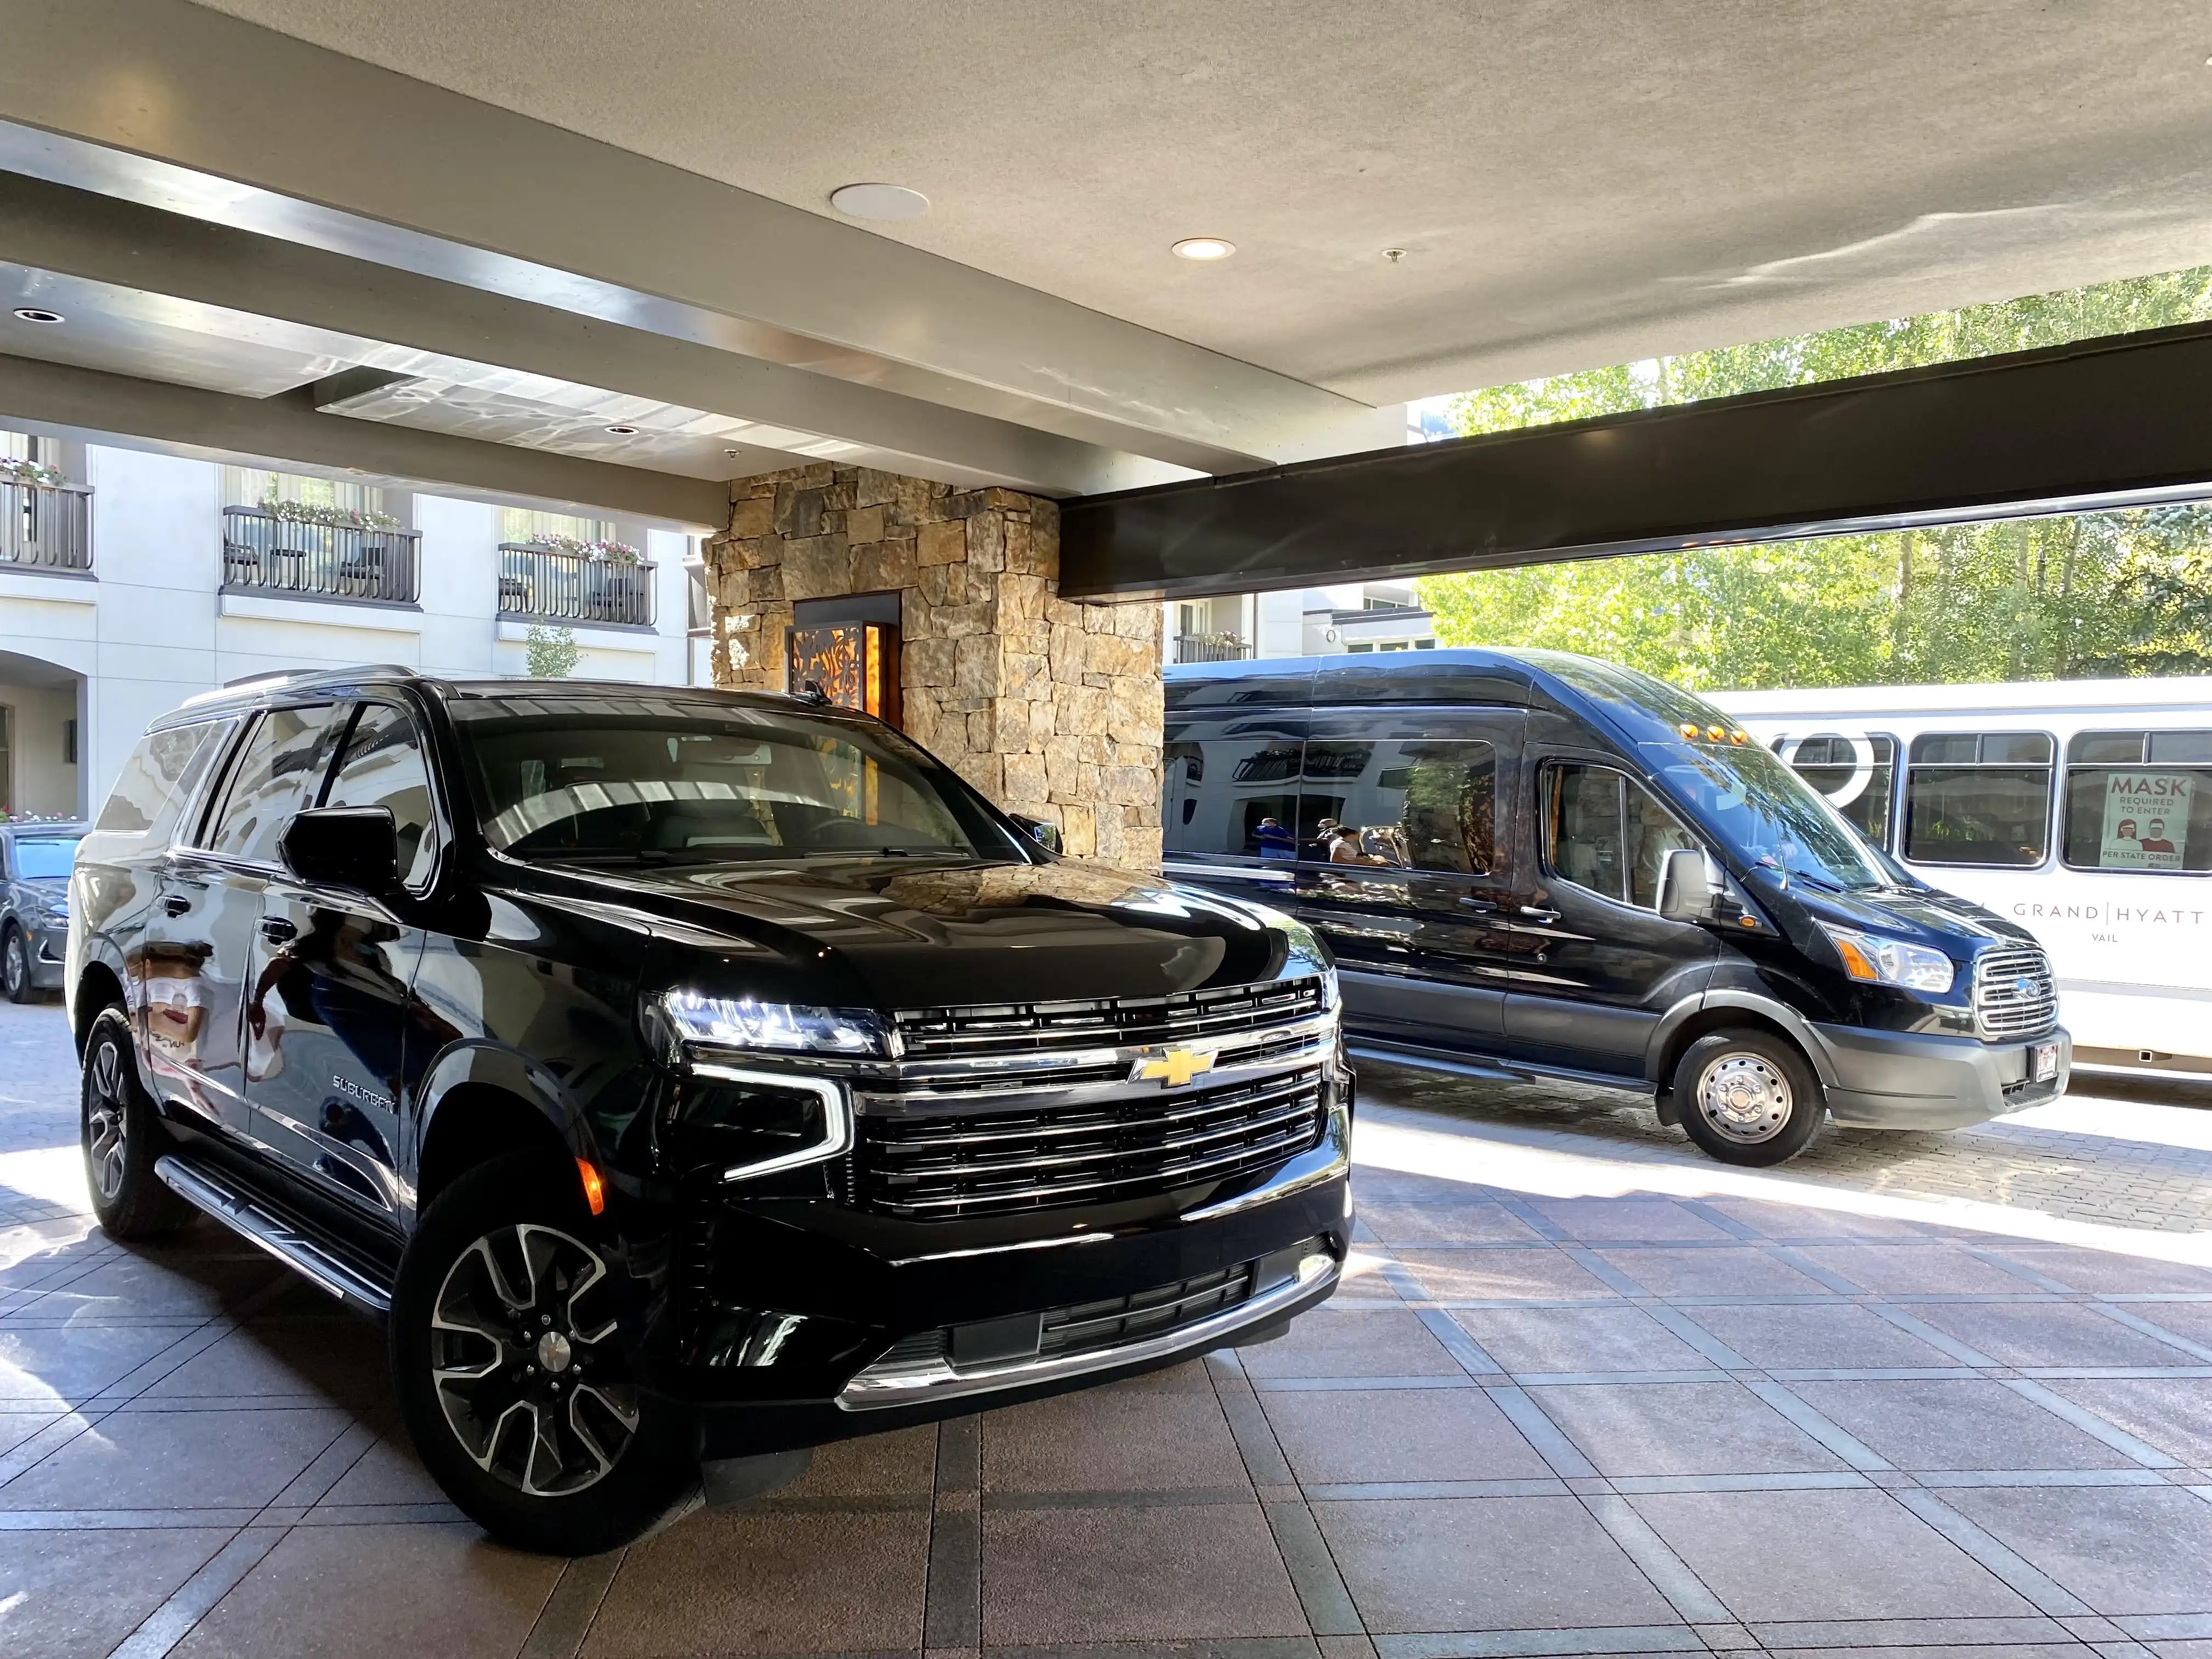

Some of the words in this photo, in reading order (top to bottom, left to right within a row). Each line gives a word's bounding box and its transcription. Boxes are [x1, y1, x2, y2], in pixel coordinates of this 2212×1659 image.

[2111, 776, 2187, 797] MASK
[2120, 797, 2174, 806] REQUIRED
[2137, 807, 2171, 815] ENTER
[2148, 854, 2181, 862] ORDER
[2013, 903, 2098, 919] GRAND
[2117, 907, 2205, 924] HYATT
[2091, 933, 2118, 943] VAIL
